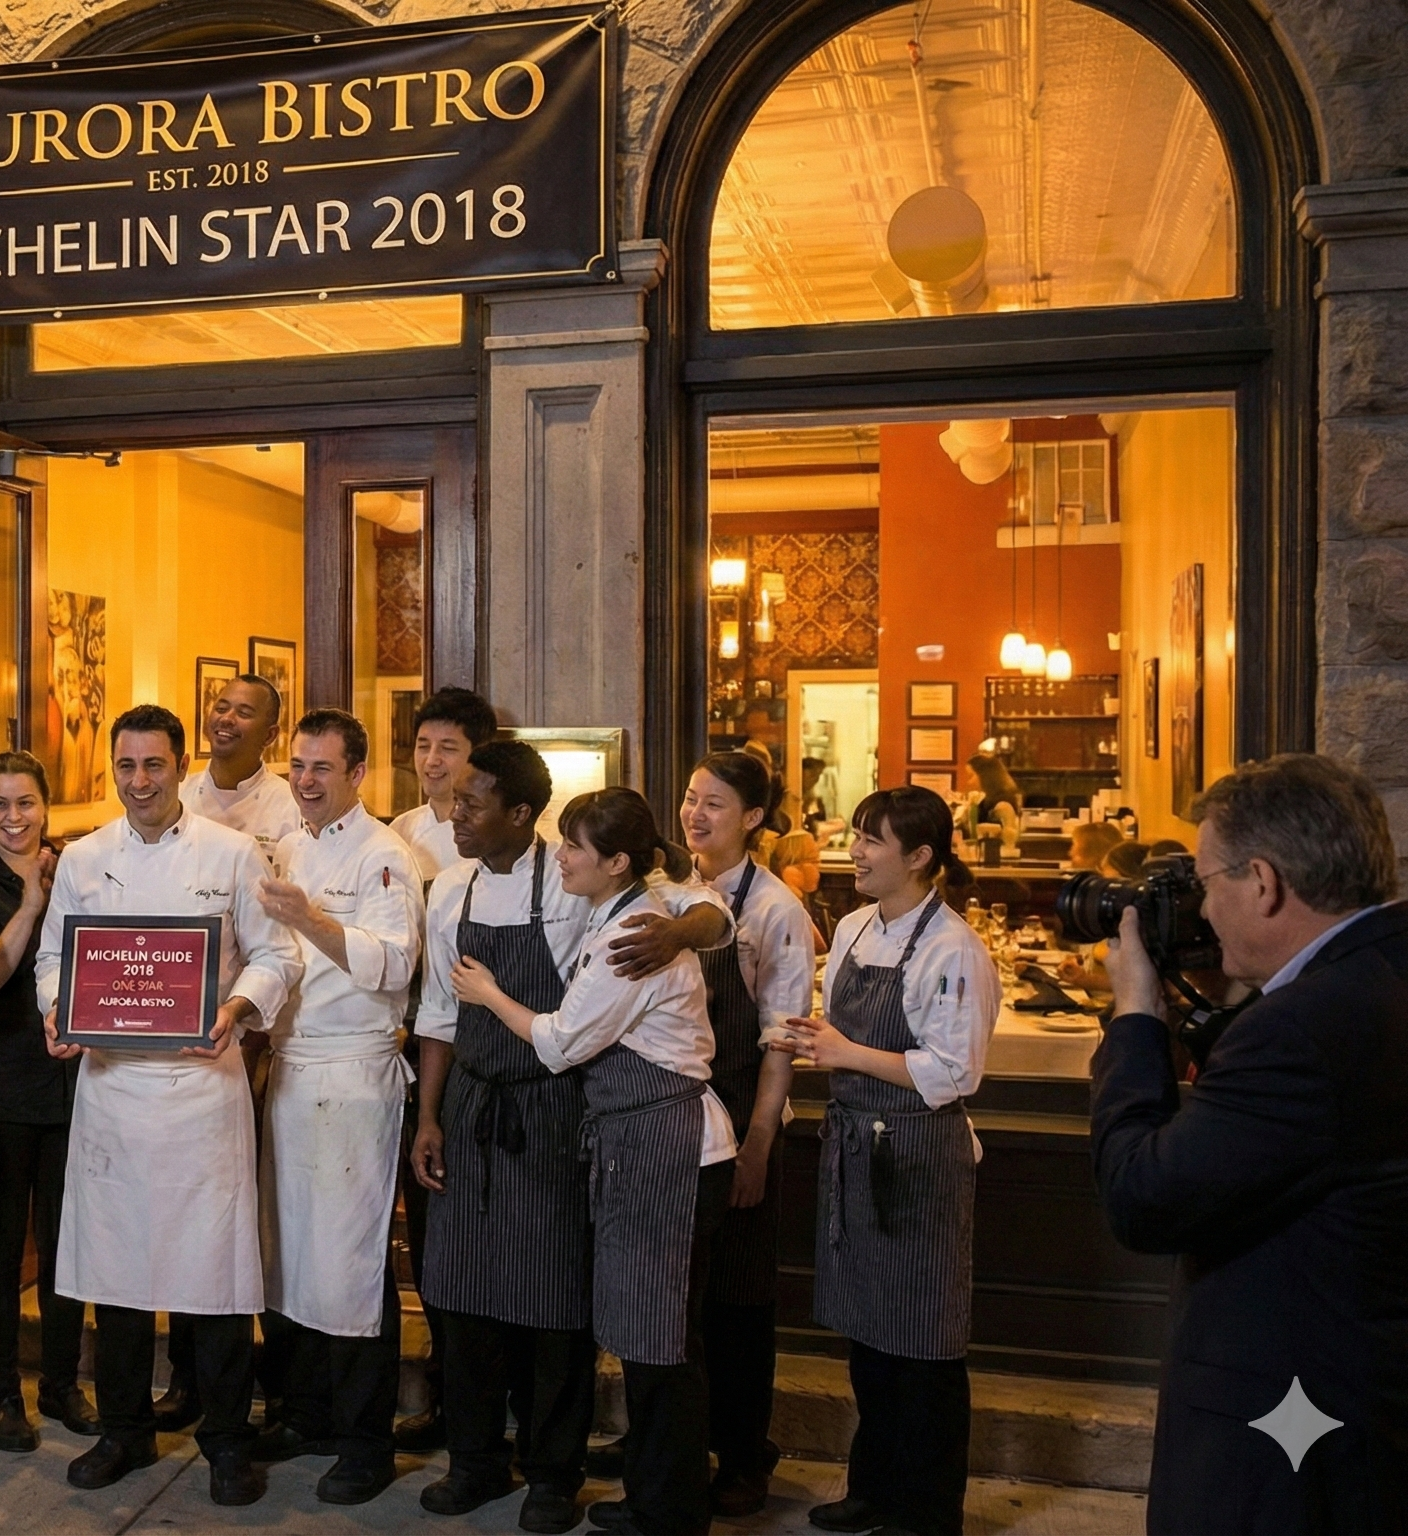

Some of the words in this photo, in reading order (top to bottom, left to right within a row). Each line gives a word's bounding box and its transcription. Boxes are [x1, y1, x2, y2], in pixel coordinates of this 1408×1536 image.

[258, 60, 546, 145] BISTRO
[146, 166, 199, 193] EST.
[207, 159, 270, 188] 2018
[199, 200, 352, 264] STAR
[371, 184, 527, 249] 2018
[86, 949, 148, 962] MICHELIN
[151, 951, 193, 963] GUIDE
[122, 964, 154, 976] 2018
[112, 980, 136, 991] ONE
